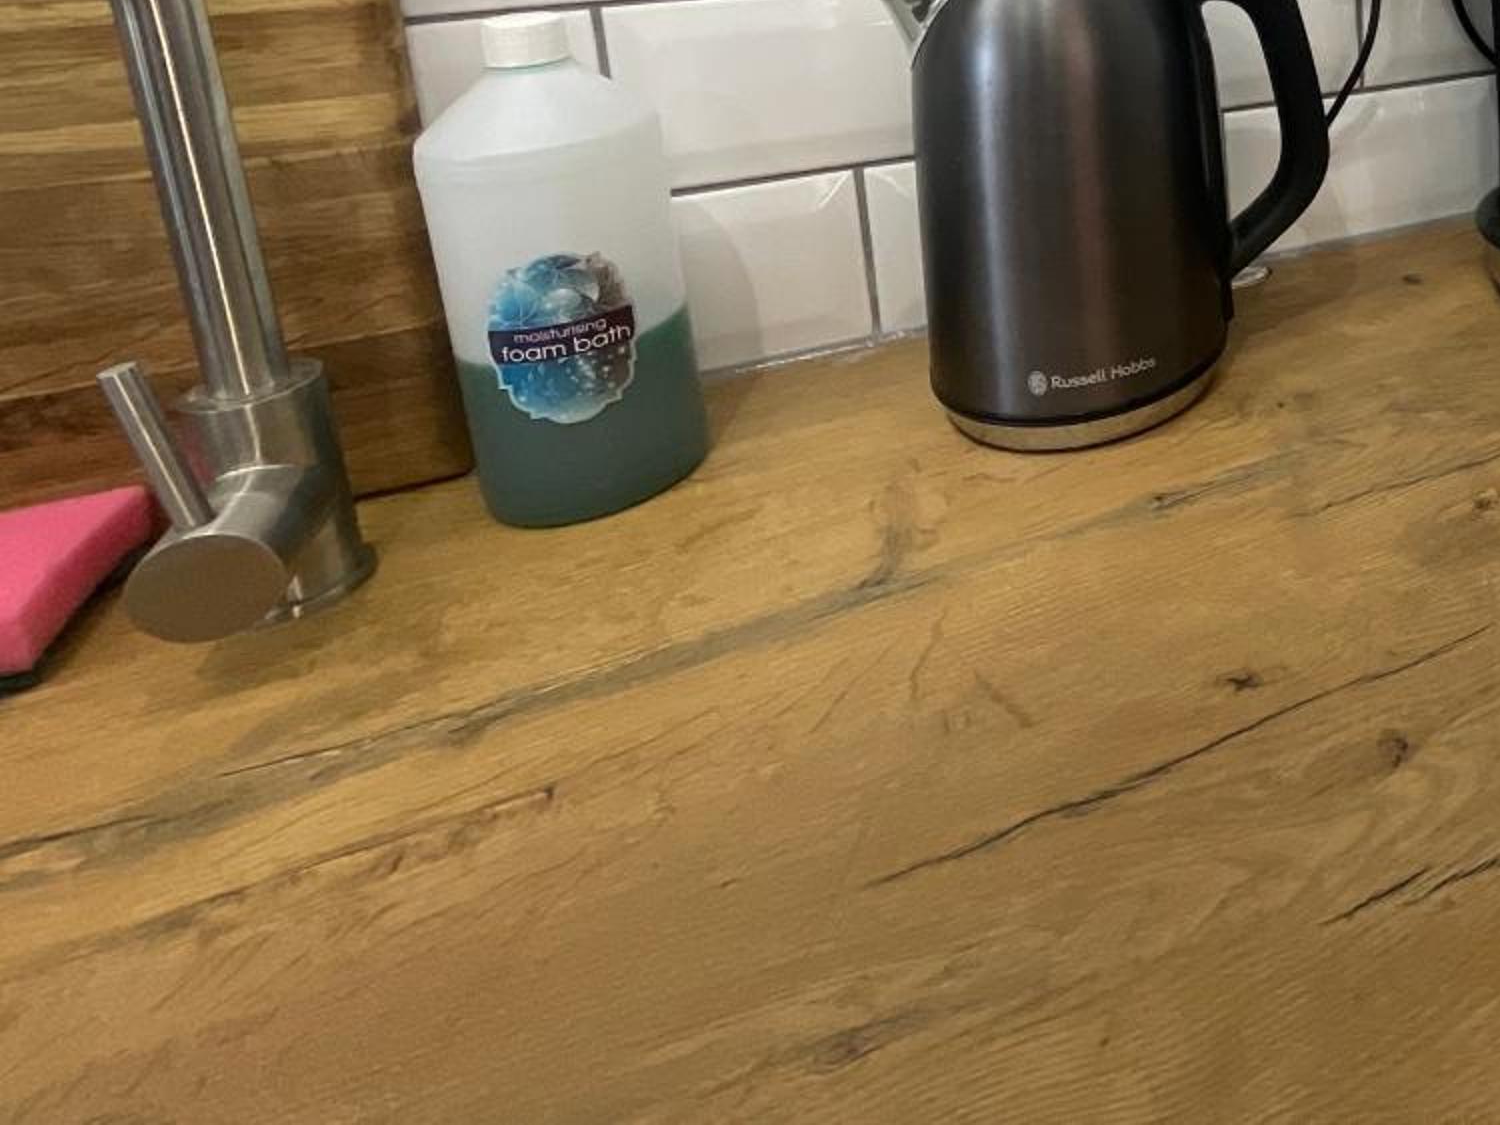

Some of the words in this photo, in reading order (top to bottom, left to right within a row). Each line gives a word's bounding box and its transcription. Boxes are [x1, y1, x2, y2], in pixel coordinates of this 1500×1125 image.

[502, 343, 567, 362] foam
[573, 325, 631, 353] bath
[1051, 368, 1107, 389] Russell
[1111, 357, 1156, 380] Hobbs
